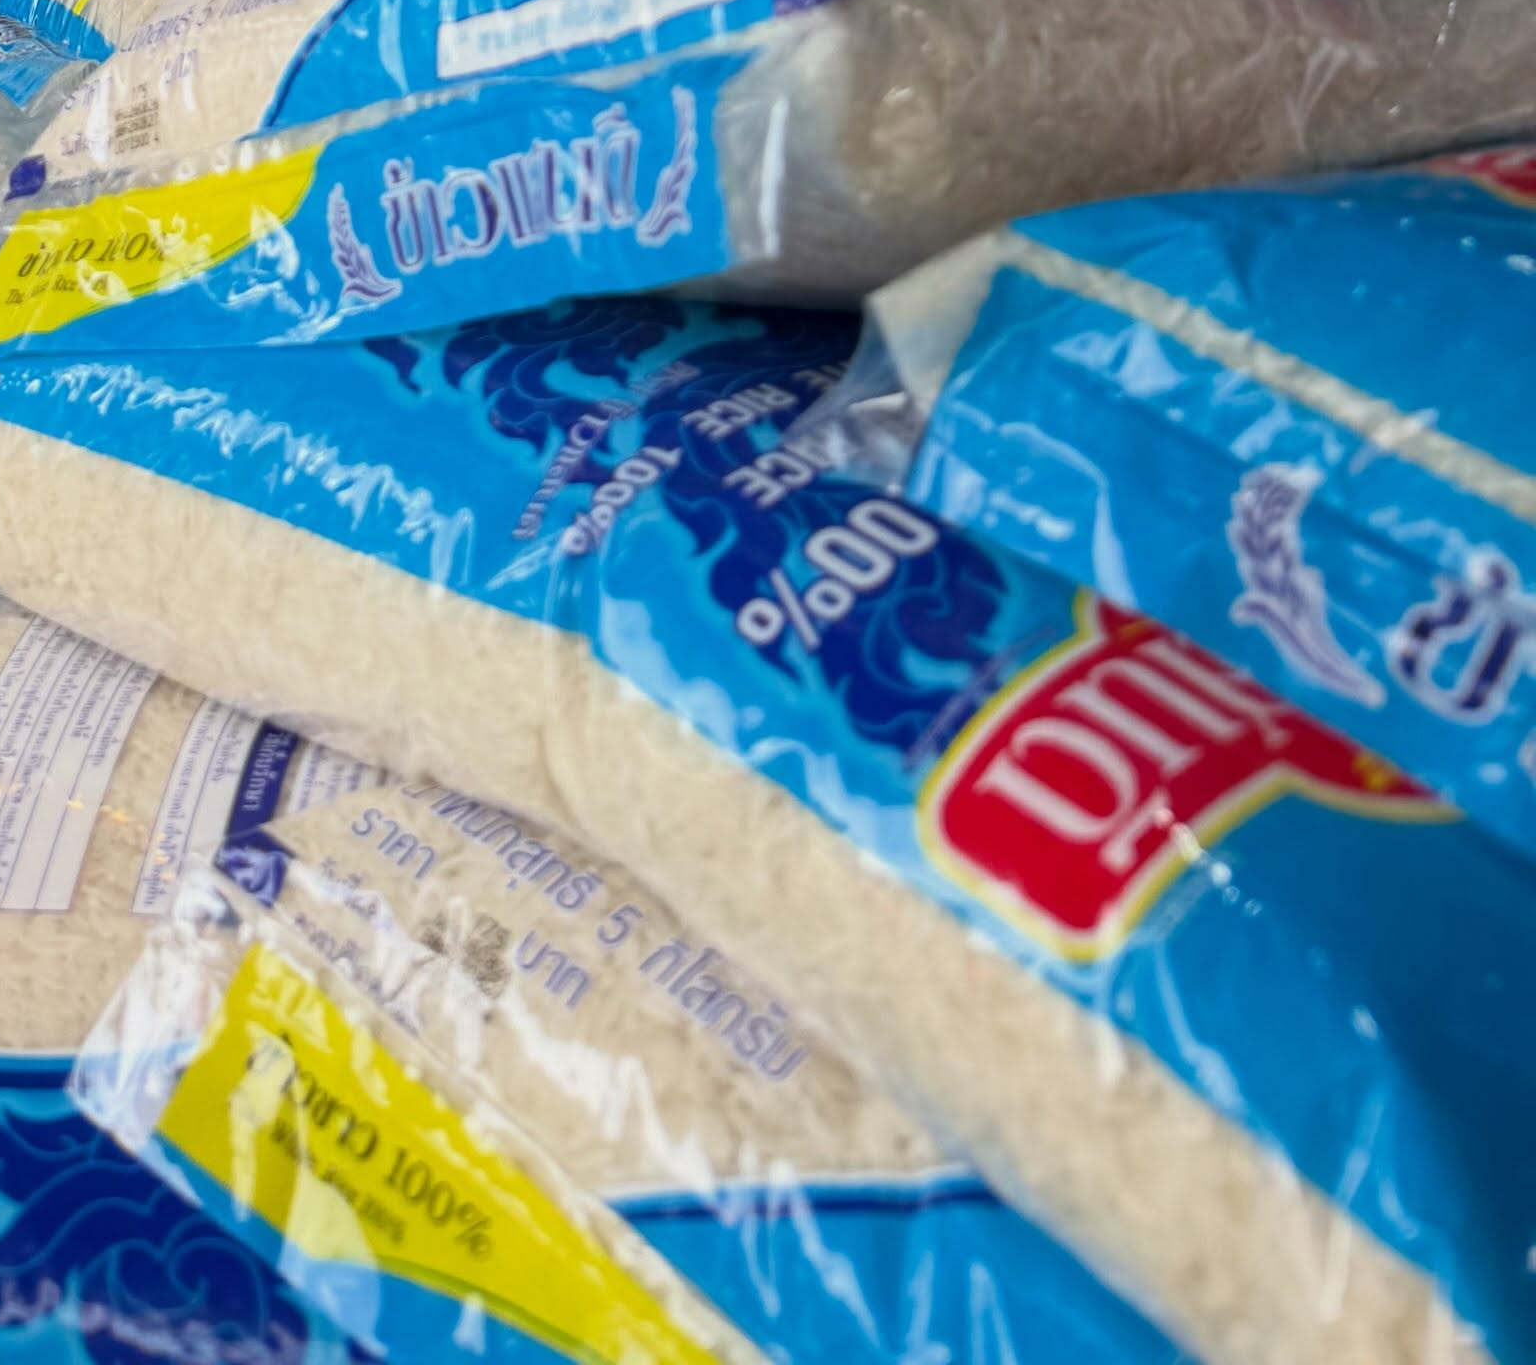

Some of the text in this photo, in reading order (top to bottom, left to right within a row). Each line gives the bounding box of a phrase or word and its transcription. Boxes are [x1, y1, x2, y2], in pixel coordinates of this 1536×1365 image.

[730, 496, 941, 652] 00%
[347, 799, 596, 1010] ราคา บาท
[593, 897, 817, 1091] 5 กิโลกรัม
[380, 1147, 505, 1263] 100%
